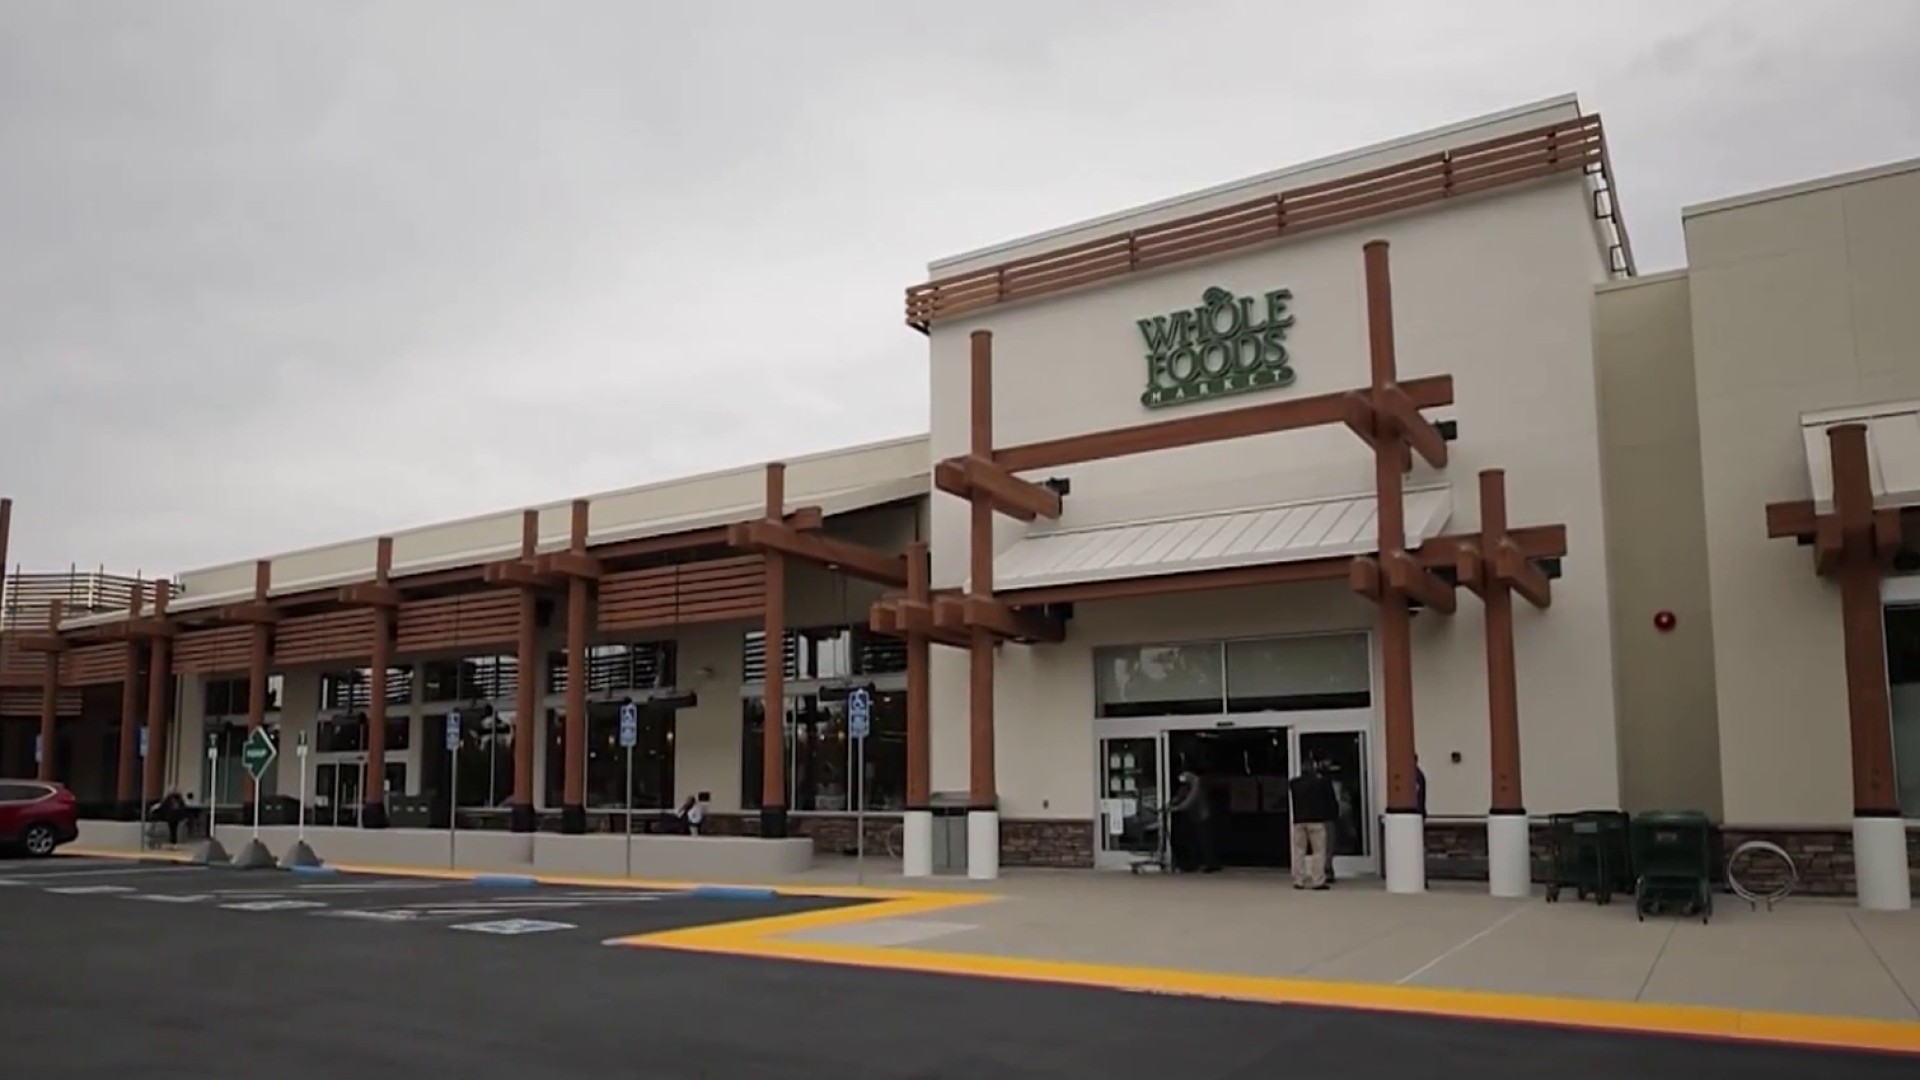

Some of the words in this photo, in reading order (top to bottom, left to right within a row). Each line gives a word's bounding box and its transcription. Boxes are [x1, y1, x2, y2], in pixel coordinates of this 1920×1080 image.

[1136, 288, 1296, 354] WHOLE
[1145, 328, 1289, 389] FOODS
[1152, 369, 1281, 402] MARKET
